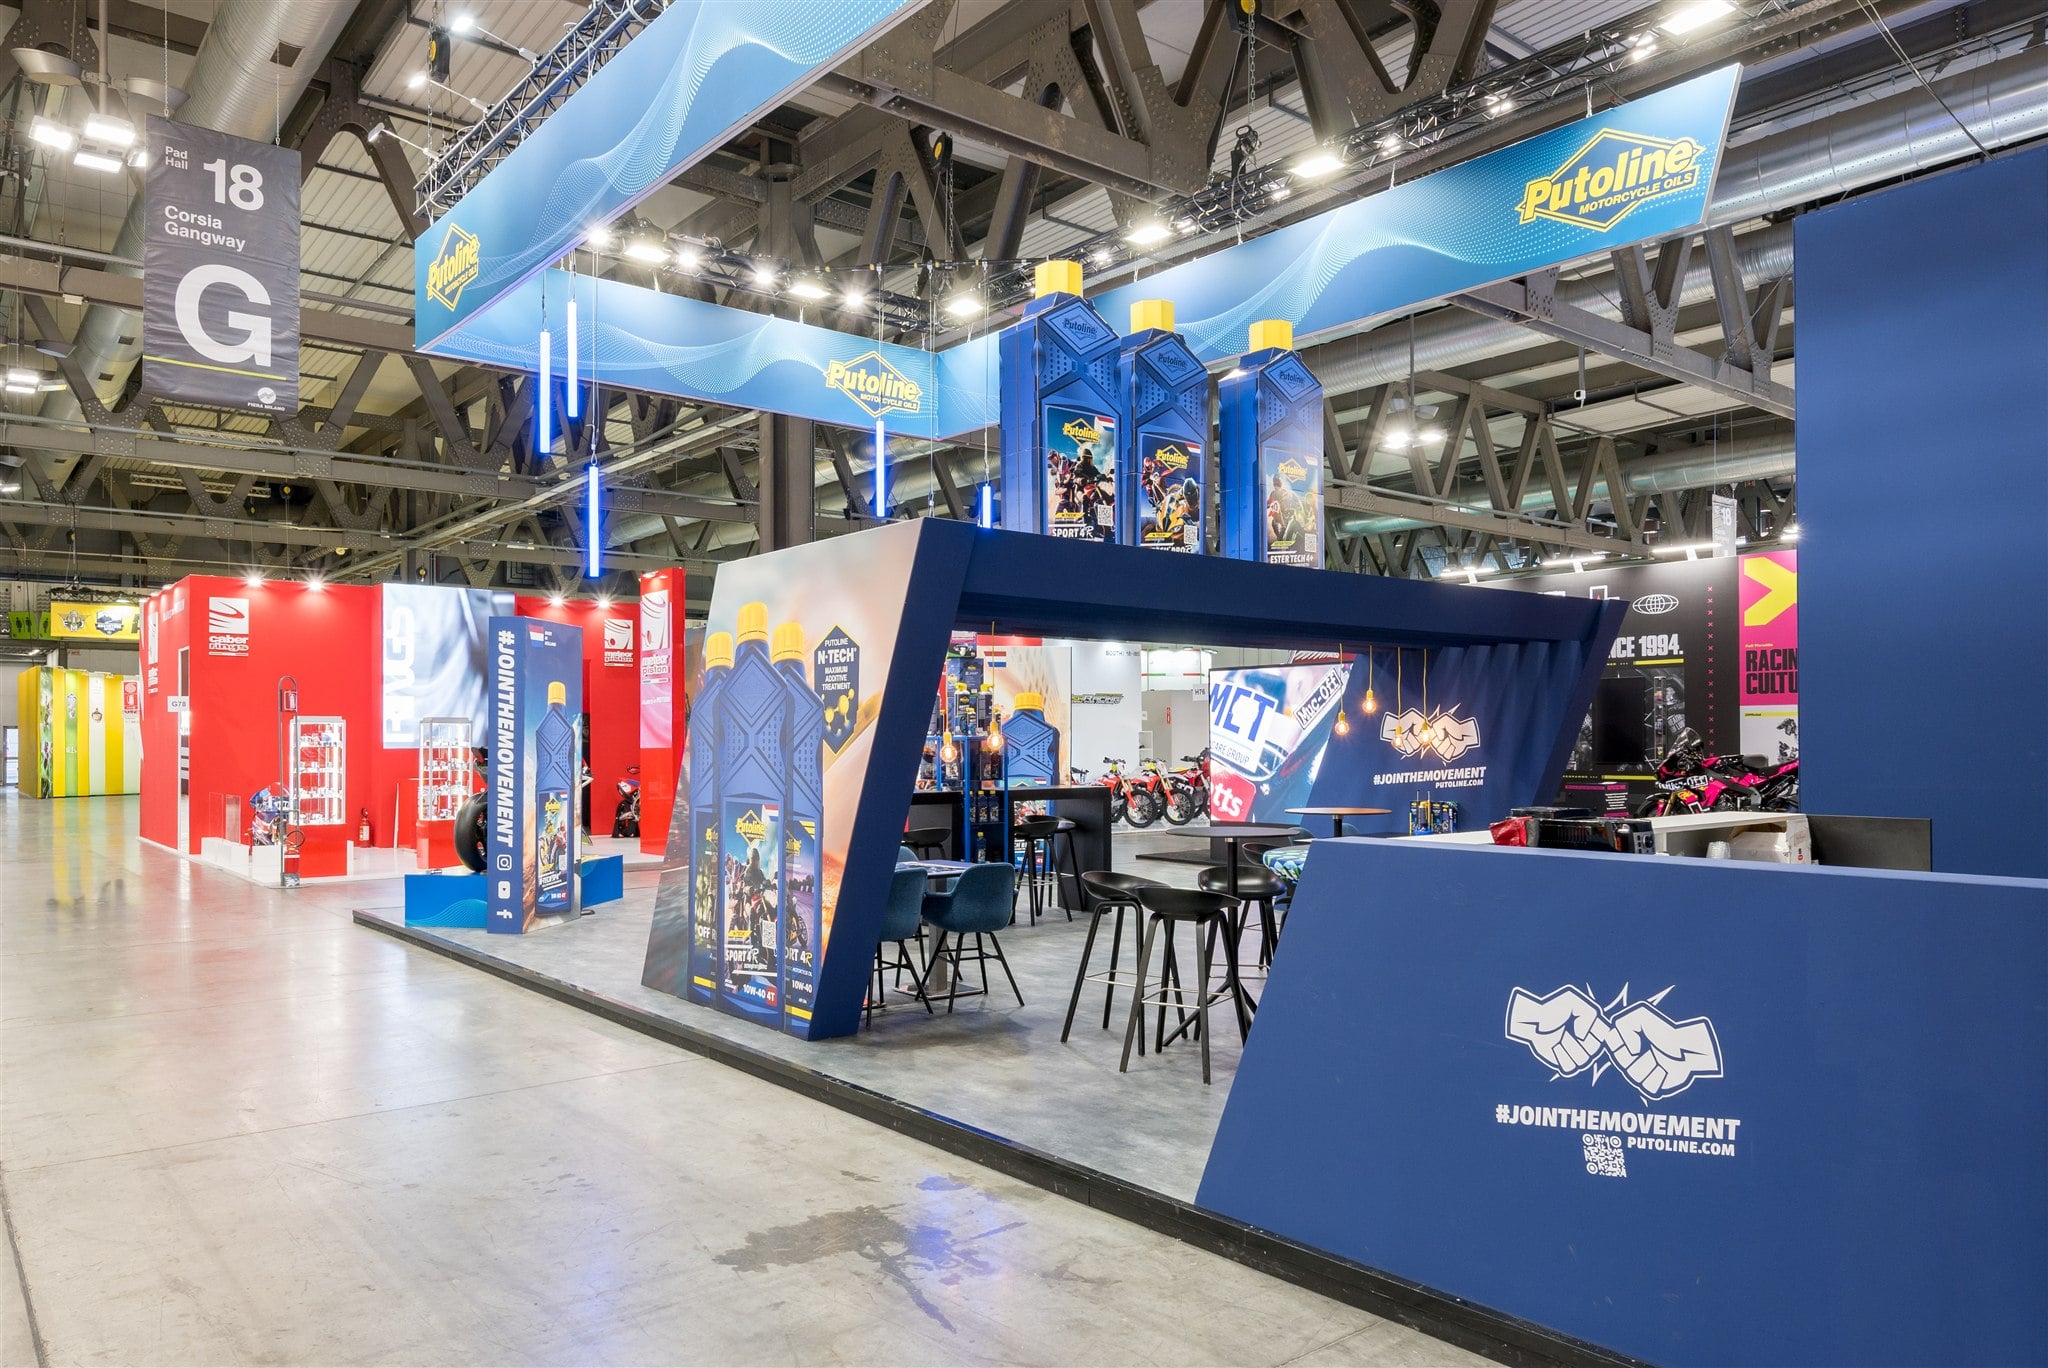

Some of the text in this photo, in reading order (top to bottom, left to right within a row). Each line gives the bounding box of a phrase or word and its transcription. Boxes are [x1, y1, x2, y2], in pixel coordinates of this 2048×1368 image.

[165, 146, 188, 159] Pad
[165, 156, 188, 170] Hall
[203, 158, 265, 211] 18
[1523, 141, 1694, 218] Putoline
[1579, 172, 1693, 215] MOTORCYCLE OILS
[164, 205, 222, 229] Corsia
[164, 221, 246, 252] Gangway
[427, 236, 479, 299] Putoline
[175, 264, 272, 367] G
[1063, 317, 1098, 336] Putoline
[1157, 353, 1188, 371] Putoline
[827, 361, 918, 400] Putoline
[903, 402, 918, 410] OILS
[1063, 422, 1100, 440] Putoline
[1156, 449, 1189, 465] Putoline
[1279, 462, 1307, 477] Putoline
[1052, 527, 1079, 538] SPORT
[1270, 554, 1289, 564] ESTER
[1290, 554, 1305, 563] TECH
[209, 634, 249, 643] caber
[825, 638, 849, 647] PUTOLINE
[1638, 633, 1684, 657] 1994.
[209, 643, 249, 652] rings
[642, 654, 669, 666] meteor
[642, 666, 668, 676] piston
[825, 665, 849, 675] MAXIMUM
[822, 682, 851, 691] TREATMENT
[825, 674, 848, 683] ADDITIVE
[1297, 669, 1342, 725] Muc-Off
[497, 630, 516, 848] #JOINTHEMOVEMENT
[1226, 747, 1250, 766] GROUP
[1373, 766, 1487, 786] #JOINTHEMOVEMENT
[1435, 779, 1484, 789] PUTOLINE.COM
[736, 819, 766, 835] Putoline
[698, 926, 711, 939] OFF
[726, 949, 746, 962] SPORT
[743, 983, 766, 999] 10W-40
[766, 991, 776, 1002] 4T
[792, 979, 813, 994] 10W-40
[1496, 1104, 1741, 1141] #JOINTHEMOVEMENT
[1628, 1136, 1735, 1157] PUTOLINE.COM
